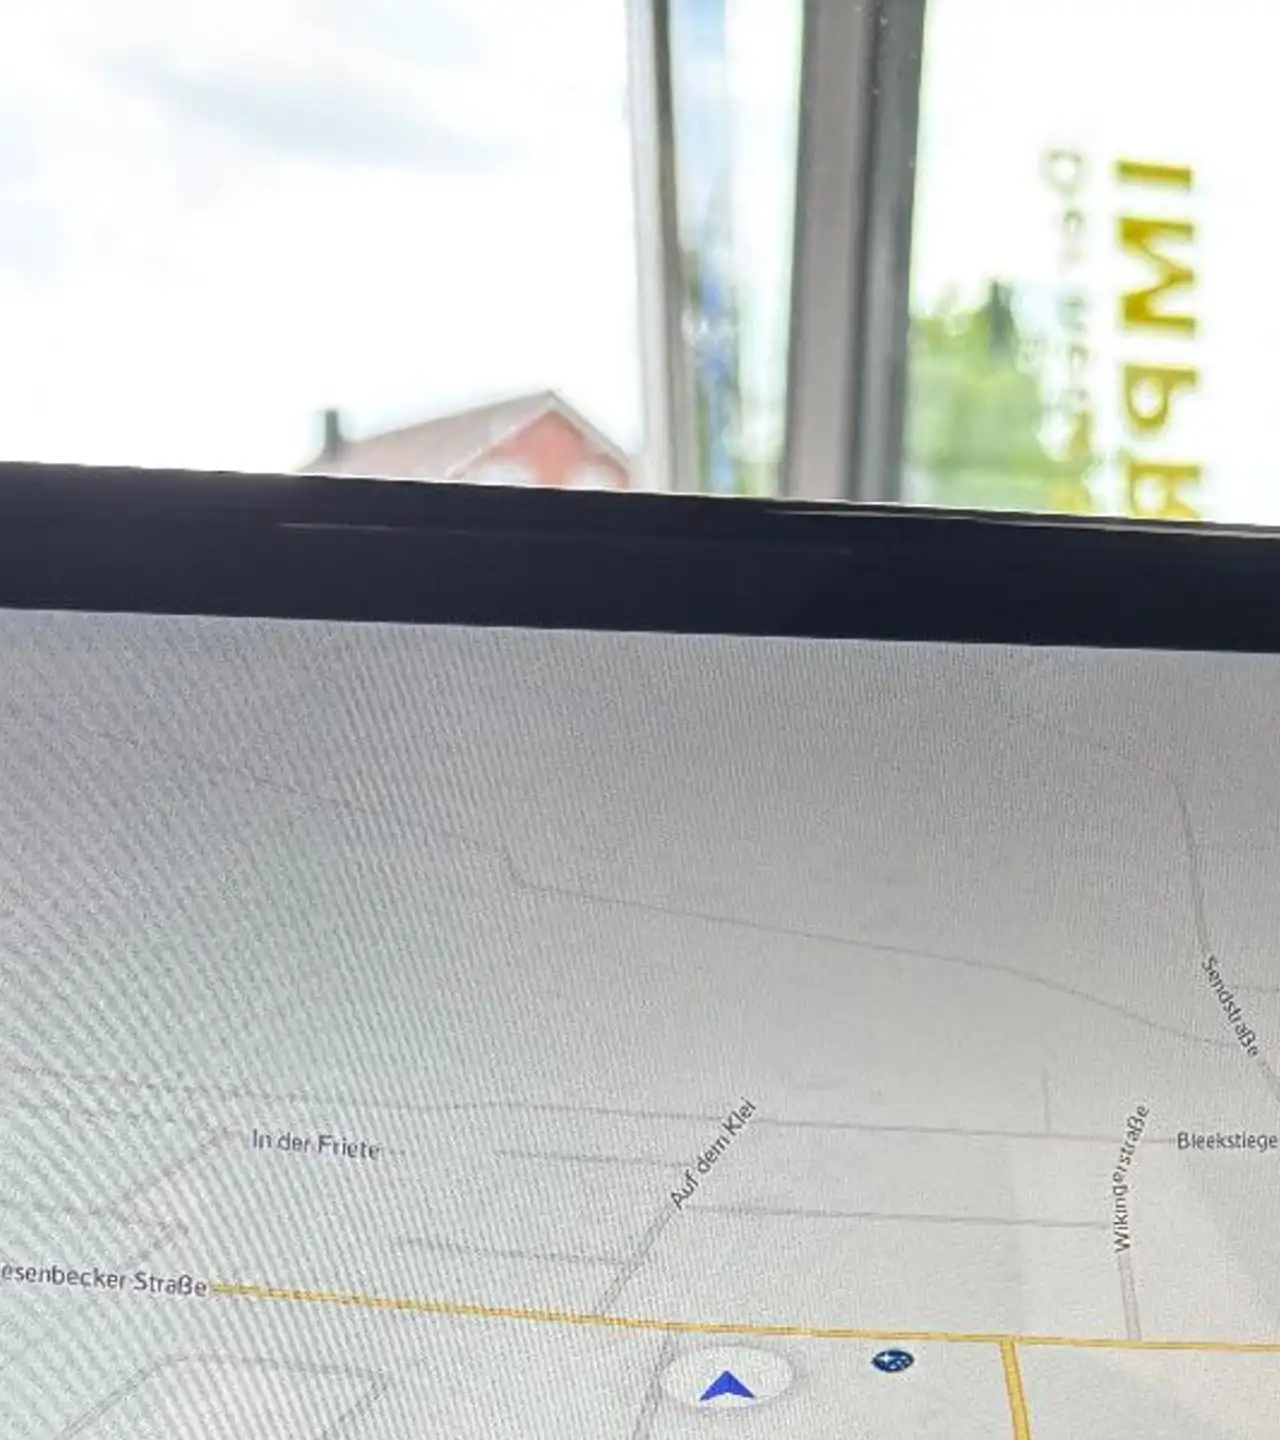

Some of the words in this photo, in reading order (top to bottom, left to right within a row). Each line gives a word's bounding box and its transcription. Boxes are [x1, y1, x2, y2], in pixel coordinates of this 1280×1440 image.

[1200, 955, 1260, 1058] Sendstraße
[252, 1128, 272, 1149] In
[277, 1132, 312, 1153] der
[670, 1168, 699, 1211] Auf
[697, 1135, 731, 1174] dem
[721, 1096, 757, 1136] Klei
[1177, 1131, 1278, 1153] Bleekstiege
[1112, 1104, 1150, 1252] Wikingerstraße
[133, 1271, 207, 1298] Straße
